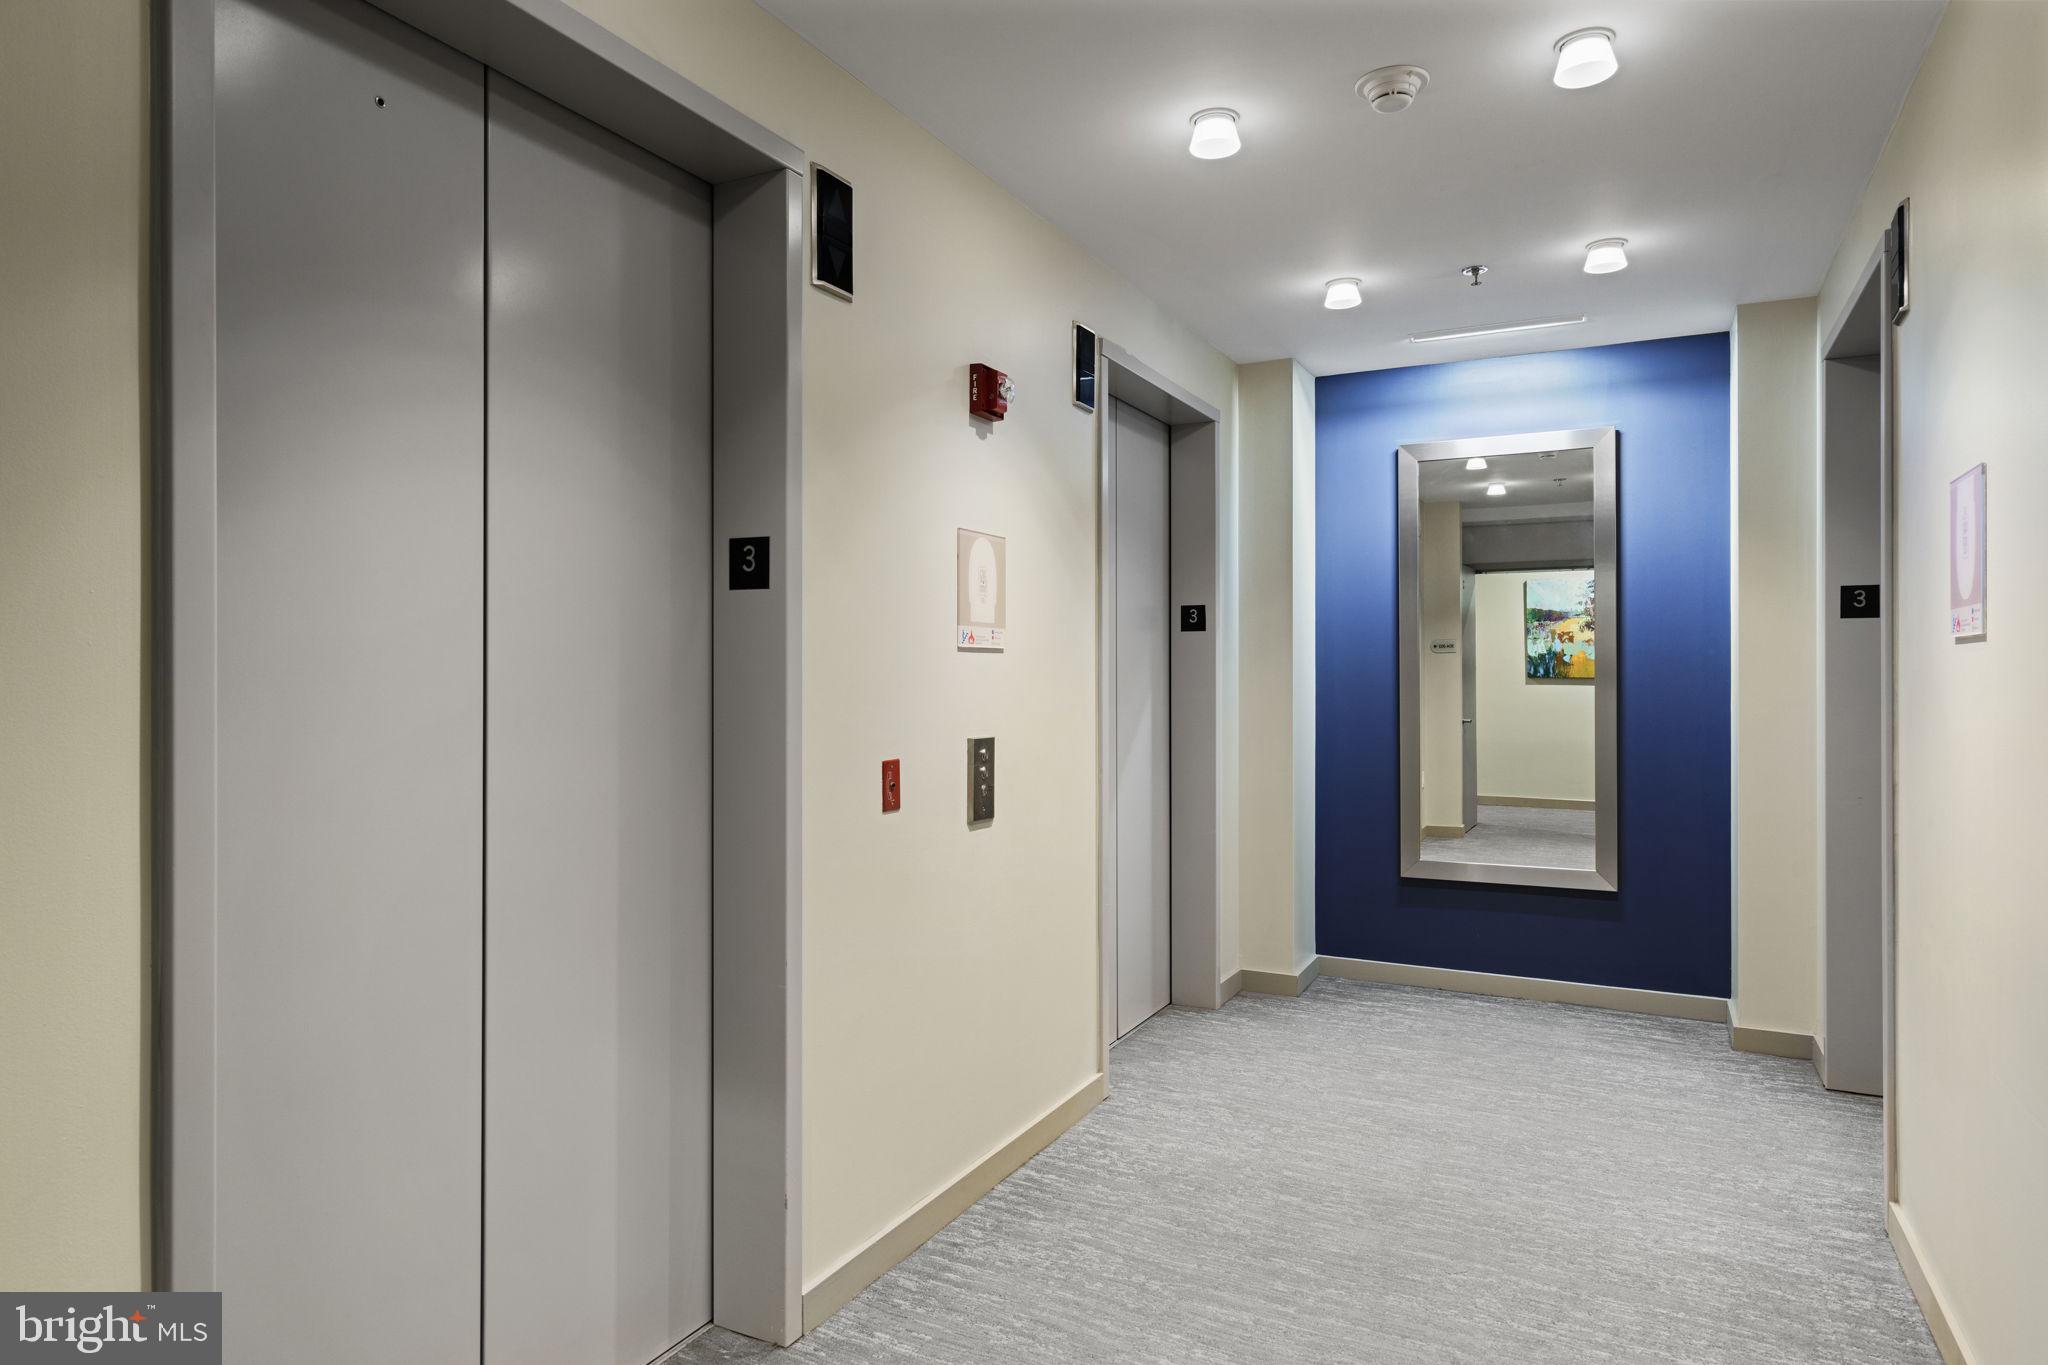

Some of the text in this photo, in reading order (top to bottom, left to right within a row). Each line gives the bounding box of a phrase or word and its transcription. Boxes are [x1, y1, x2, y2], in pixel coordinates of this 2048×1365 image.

[742, 545, 755, 572] 3
[1853, 590, 1866, 607] 3
[1189, 608, 1198, 623] 3
